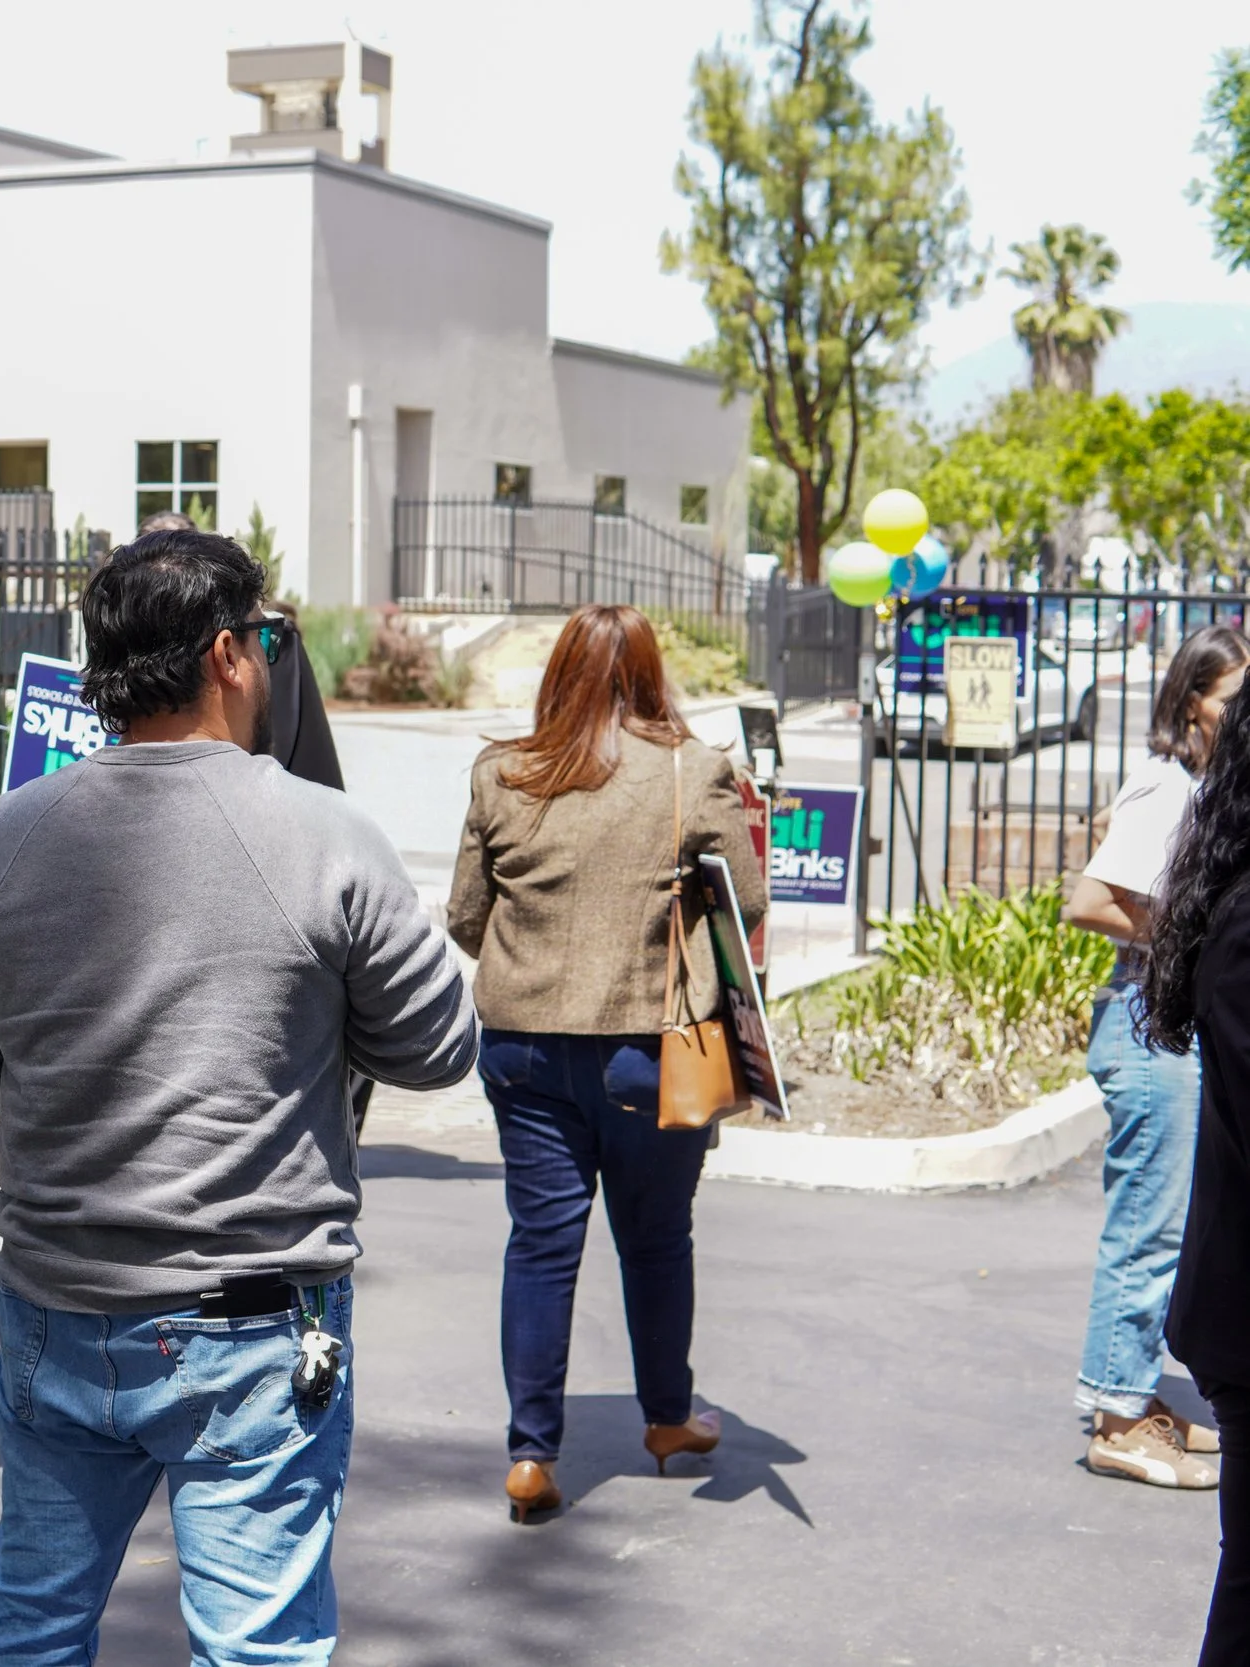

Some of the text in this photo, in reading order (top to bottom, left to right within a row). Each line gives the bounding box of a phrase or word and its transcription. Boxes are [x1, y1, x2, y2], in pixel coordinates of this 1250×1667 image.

[950, 644, 1012, 669] SLOW
[22, 701, 105, 756] Binks
[770, 808, 825, 850] ali
[770, 847, 844, 881] Binks
